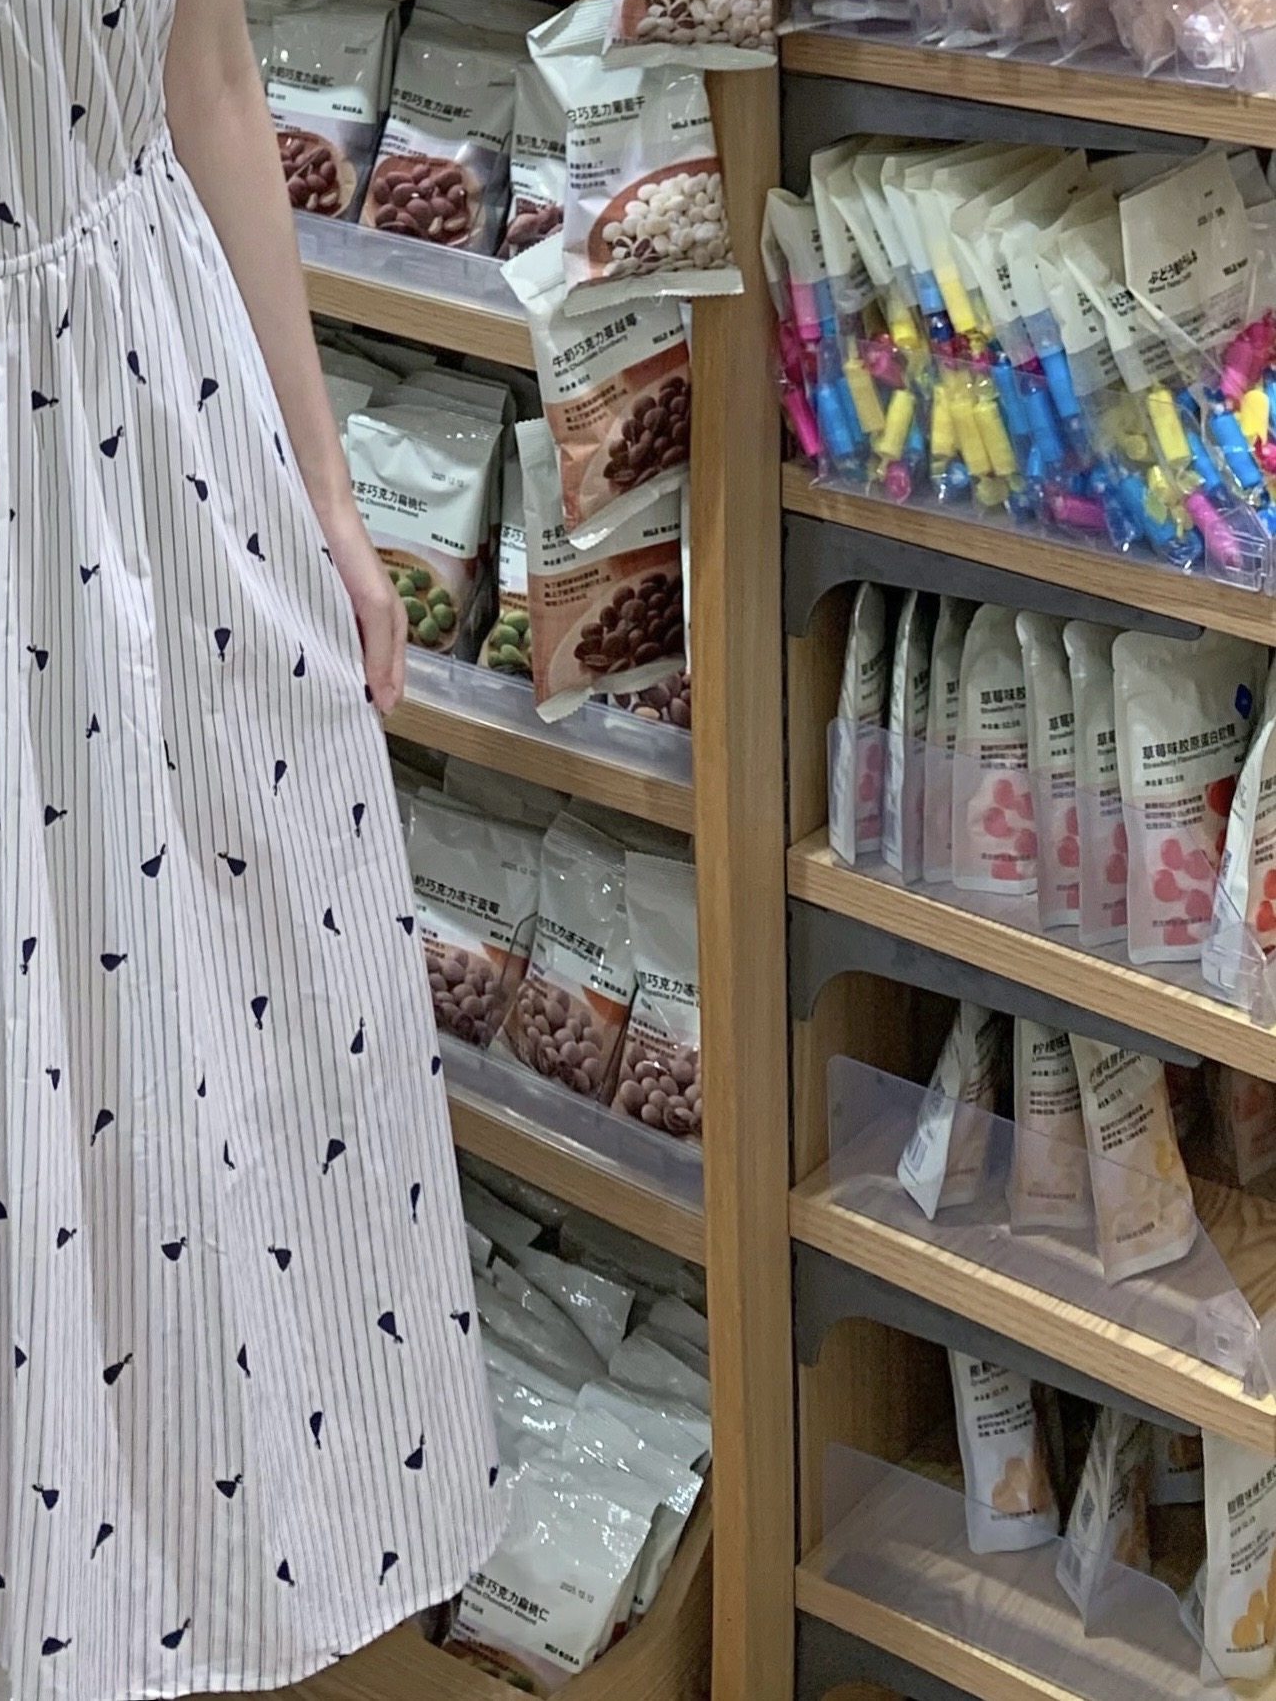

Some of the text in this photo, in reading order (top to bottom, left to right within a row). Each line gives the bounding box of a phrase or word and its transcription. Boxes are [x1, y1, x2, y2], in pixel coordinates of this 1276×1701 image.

[553, 313, 638, 368] 牛奶巧克力蔓越莓
[1142, 723, 1236, 760] 草莓味胶原蛋白软糖
[412, 875, 500, 915] 奶巧克力冻干蓝莓
